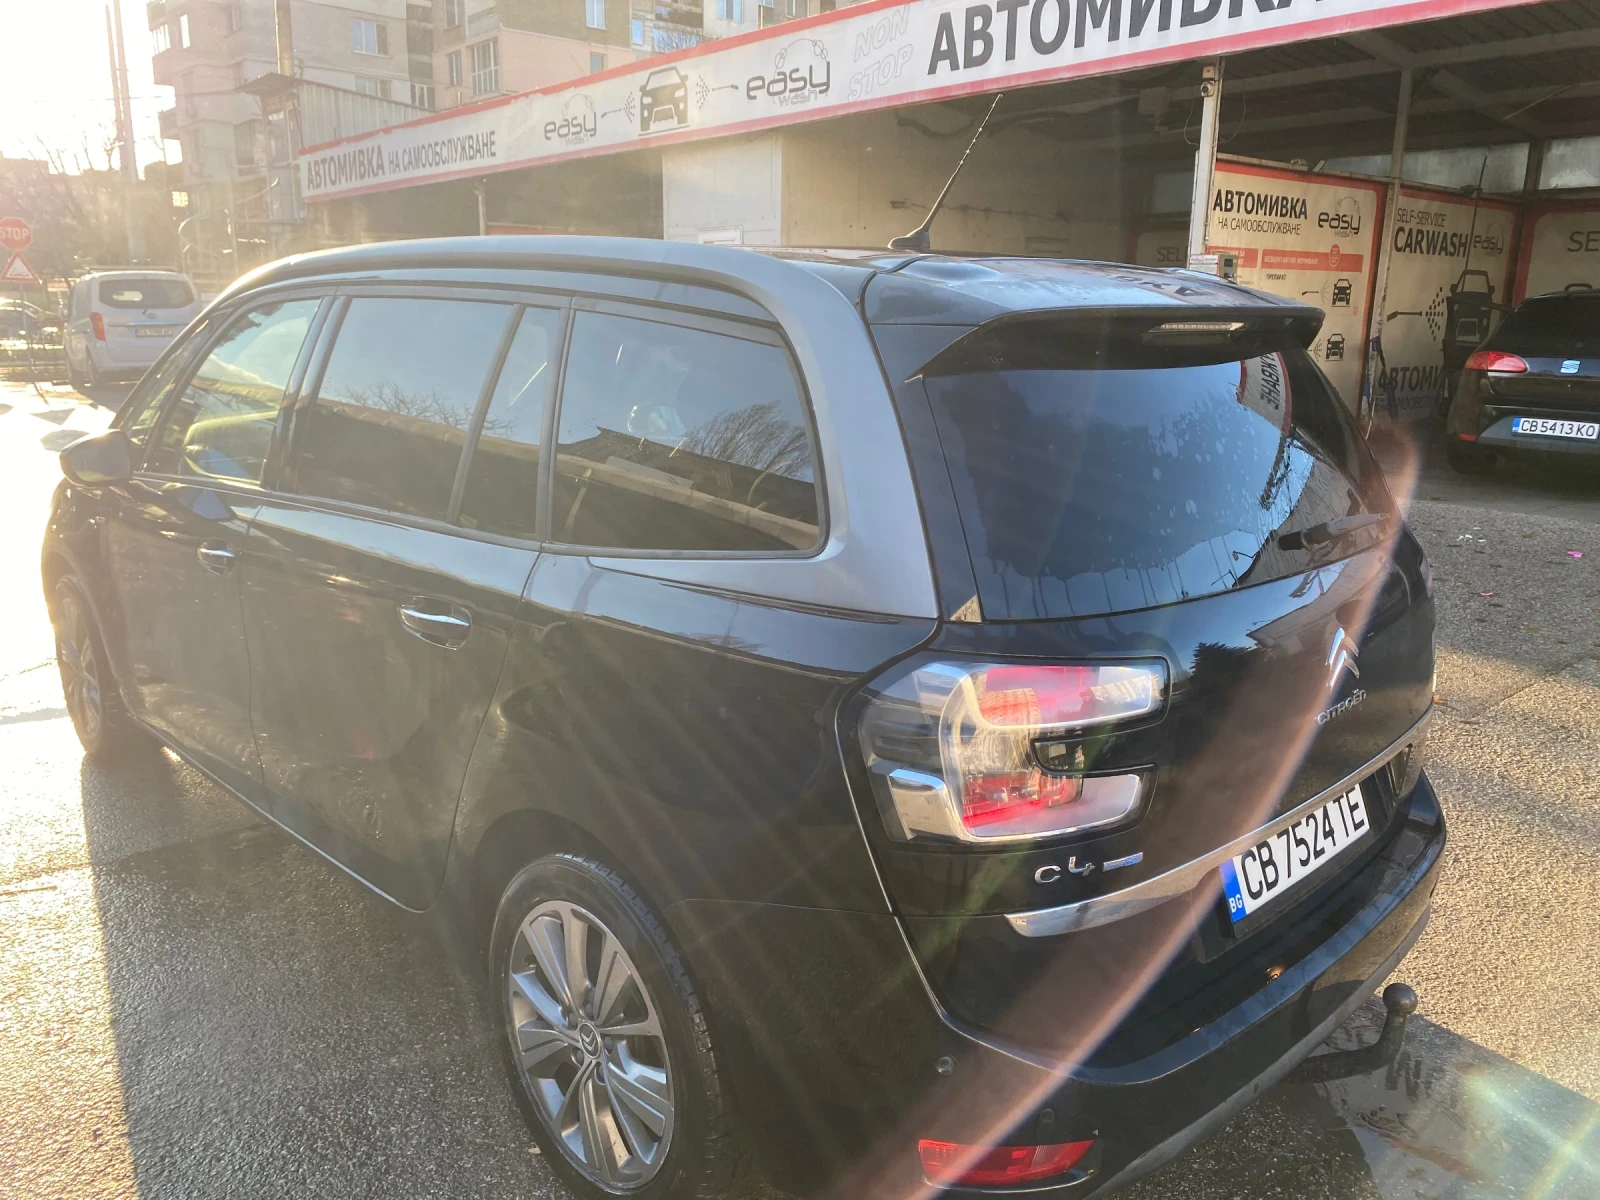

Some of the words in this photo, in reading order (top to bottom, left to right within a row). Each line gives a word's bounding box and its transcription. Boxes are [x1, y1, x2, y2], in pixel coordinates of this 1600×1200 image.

[853, 4, 911, 62] NON
[927, 0, 1326, 75] АВТОМИ
[746, 61, 831, 100] easy
[848, 43, 914, 103] STOP
[544, 111, 597, 140] easy
[307, 144, 386, 190] АВТОМИВКА
[388, 151, 401, 175] НА
[402, 130, 497, 173] САМООБСЛУЖВАНЕ
[1212, 188, 1308, 220] АВТОМИВКА
[0, 227, 29, 240] STOP
[1218, 217, 1229, 229] НА
[1230, 217, 1302, 236] САМООБСЛУЖВАНЕ
[1318, 211, 1361, 235] easy
[1394, 226, 1469, 258] CARWASH
[1473, 234, 1505, 254] easy
[1034, 856, 1096, 884] C4
[1229, 893, 1243, 913] BG
